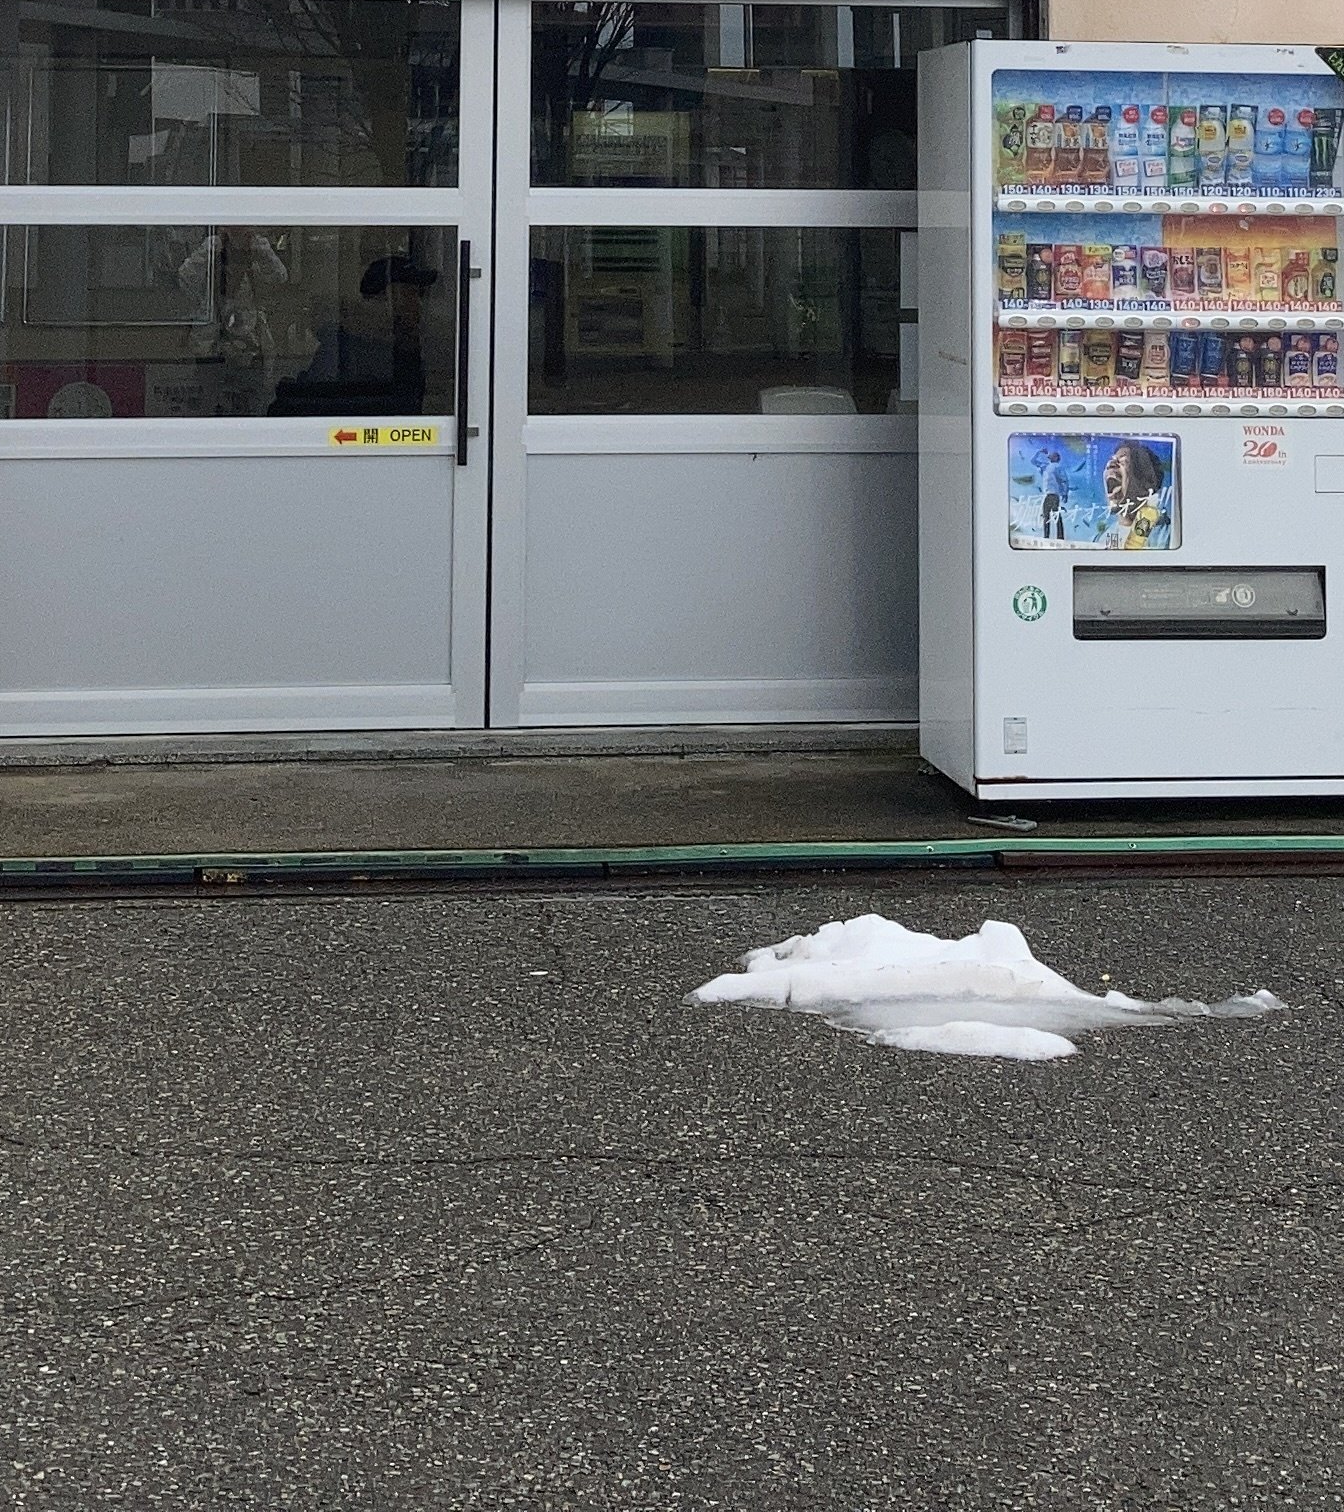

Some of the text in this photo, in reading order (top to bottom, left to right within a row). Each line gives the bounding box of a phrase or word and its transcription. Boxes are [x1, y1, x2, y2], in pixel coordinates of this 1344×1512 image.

[1003, 185, 1024, 194] 150
[1032, 185, 1052, 194] 140
[1061, 185, 1081, 194] 130
[1090, 185, 1110, 194] 130
[1202, 188, 1223, 197] 120
[1232, 188, 1252, 197] 120
[1261, 189, 1281, 198] 110
[1288, 189, 1308, 198] 110
[1003, 299, 1024, 309] 140
[1063, 299, 1083, 309] 140
[1090, 300, 1110, 310] 130
[1118, 300, 1138, 310] 140
[1146, 300, 1166, 310] 140
[1176, 301, 1196, 311] 140
[1204, 301, 1224, 311] 140
[1233, 301, 1253, 311] 140
[1261, 301, 1281, 311] 140
[1290, 302, 1309, 312] 140
[1318, 302, 1338, 312] 140
[1004, 387, 1024, 396] 130
[1032, 387, 1053, 396] 140
[1062, 387, 1082, 396] 130
[1091, 387, 1111, 396] 140
[1117, 387, 1137, 396] 140
[1148, 387, 1168, 396] 140
[1178, 388, 1198, 397] 140
[1206, 388, 1225, 397] 140
[1292, 388, 1312, 397] 140
[1320, 388, 1340, 397] 140
[363, 428, 431, 444] 開 OPEN
[1242, 426, 1285, 436] WONDA
